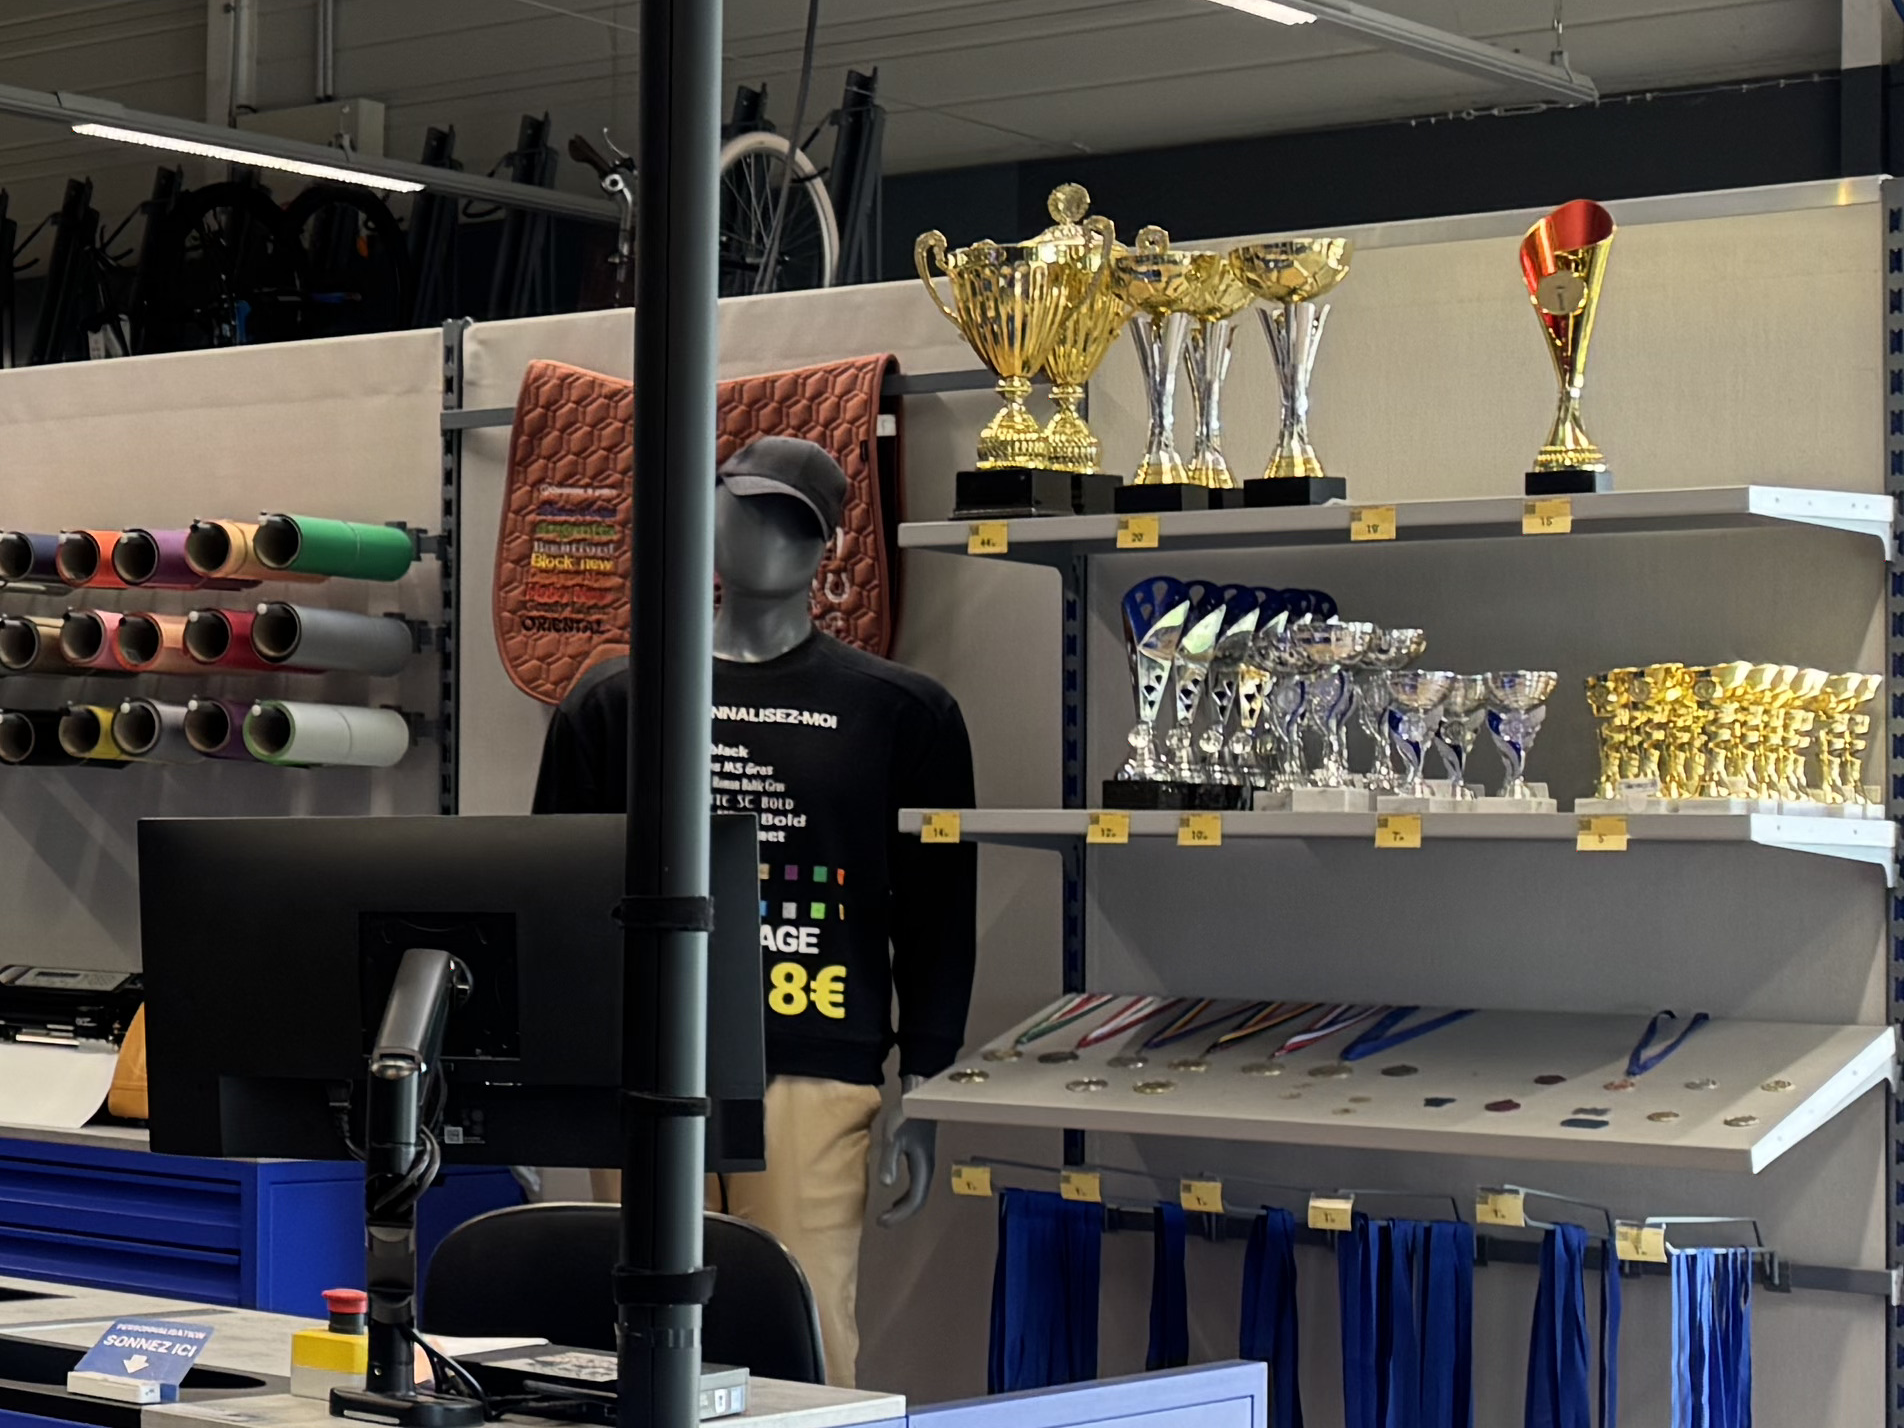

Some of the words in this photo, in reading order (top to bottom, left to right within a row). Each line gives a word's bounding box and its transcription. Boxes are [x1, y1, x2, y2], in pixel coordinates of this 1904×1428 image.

[711, 705, 838, 729] NNALISEZ-MOI
[760, 812, 807, 828] Bold
[758, 830, 787, 843] act
[759, 924, 821, 955] AGE
[767, 961, 848, 1020] 8€
[103, 1334, 171, 1353] SONNEZ
[172, 1343, 197, 1357] ICI
